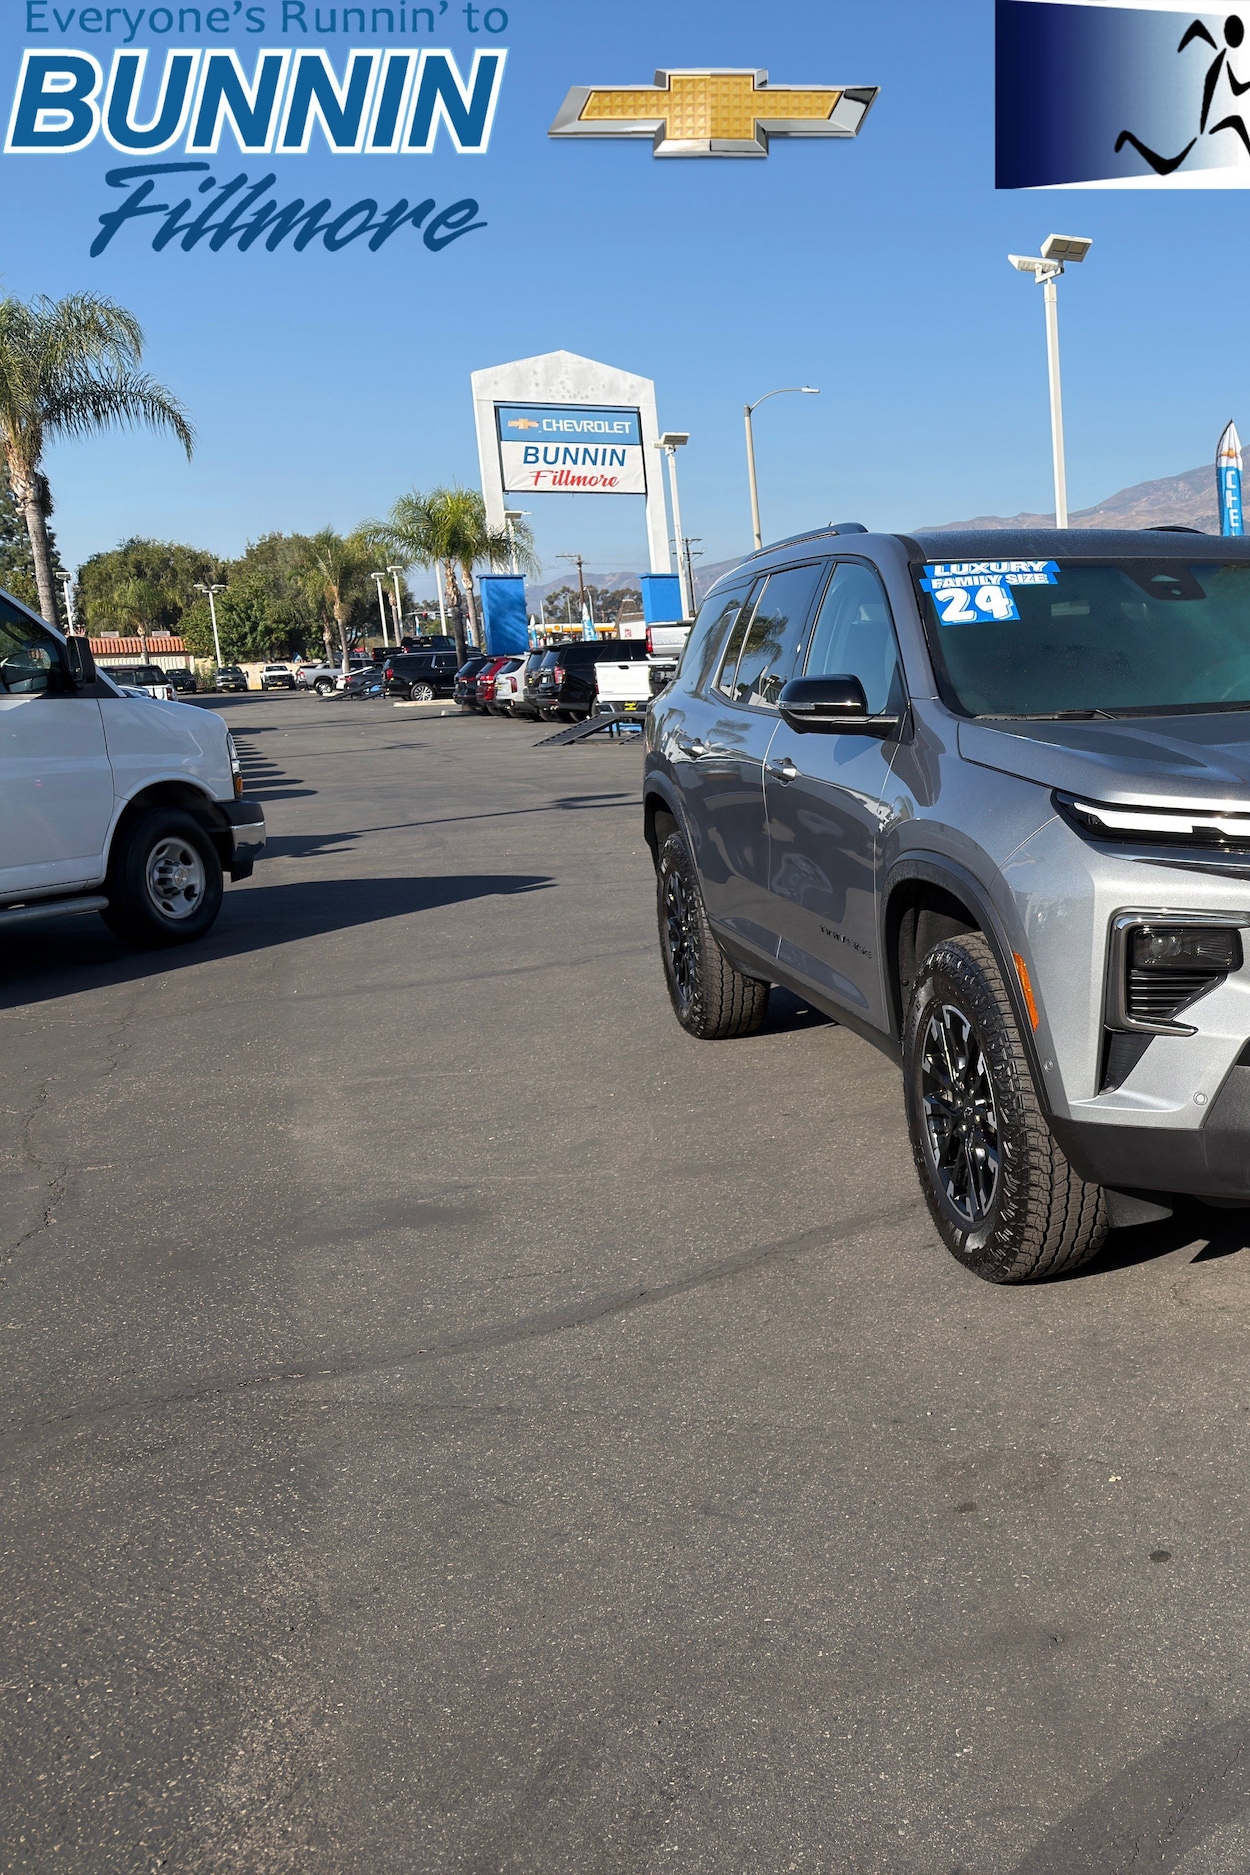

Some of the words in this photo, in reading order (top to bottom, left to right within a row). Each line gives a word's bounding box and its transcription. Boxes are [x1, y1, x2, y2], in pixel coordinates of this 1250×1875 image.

[542, 418, 631, 434] CHEVROLET
[523, 446, 626, 467] BUNNIN
[529, 470, 619, 487] Fillmore
[1226, 471, 1239, 535] CHE
[934, 561, 1048, 577] LUXURY
[931, 573, 1003, 589] FAMILY
[935, 585, 1013, 623] 24
